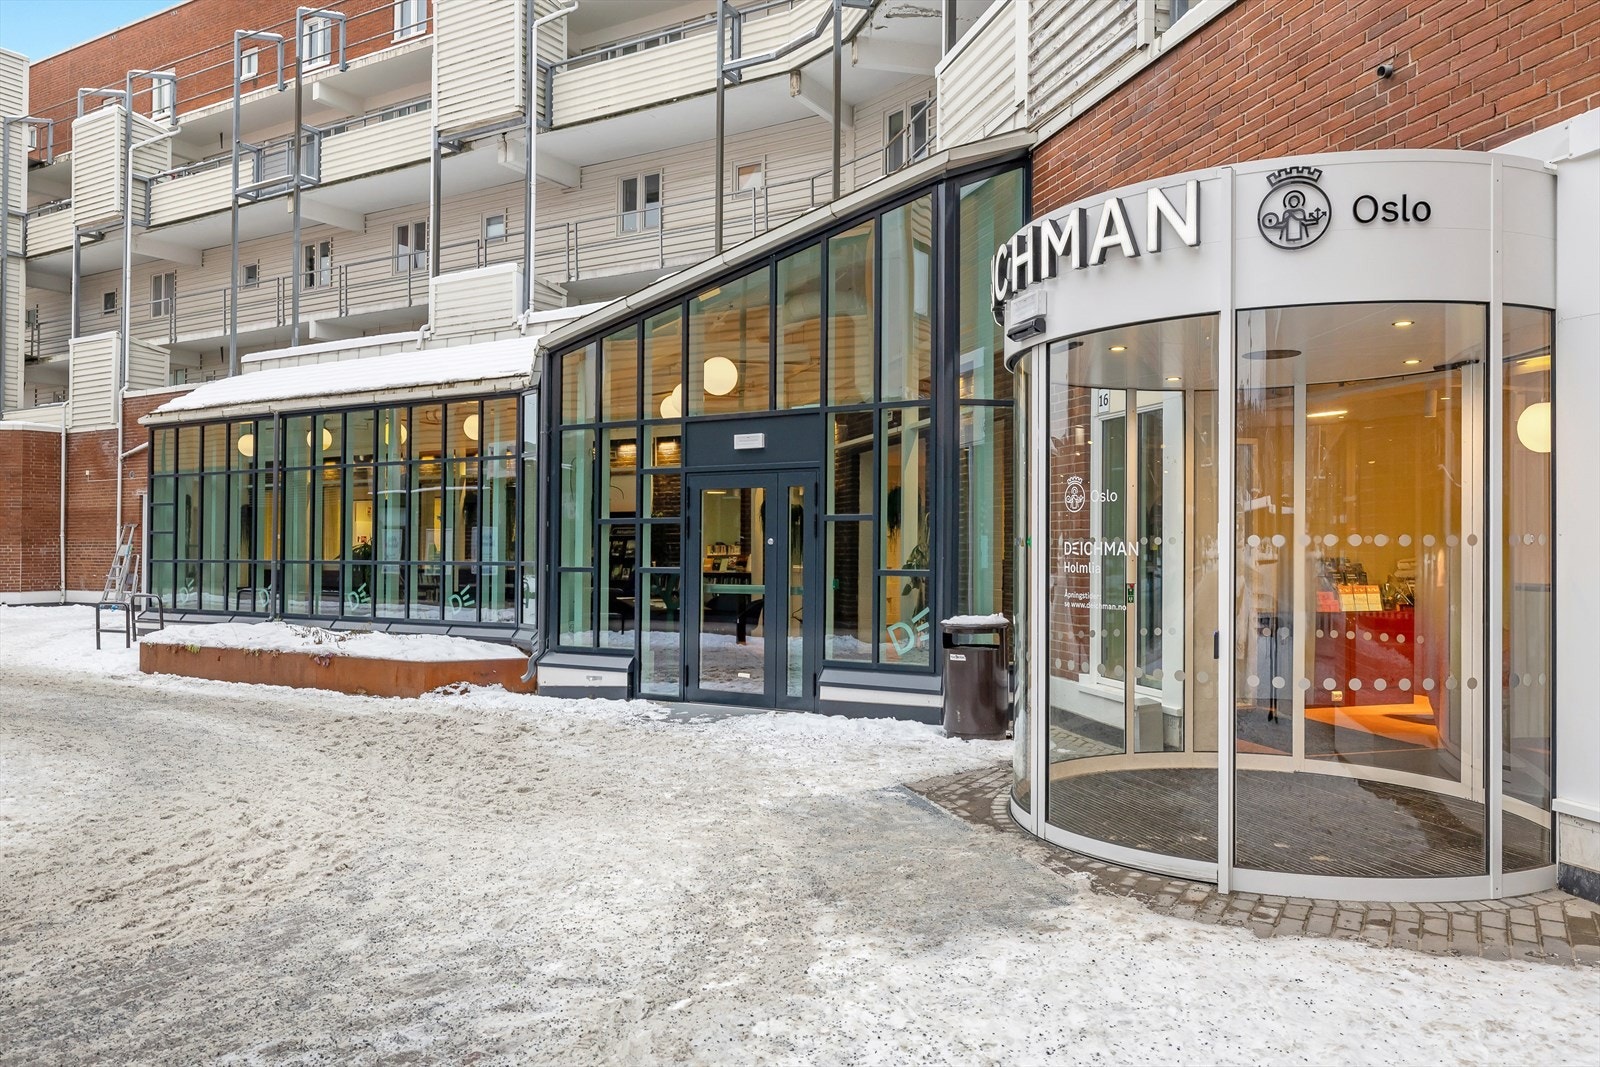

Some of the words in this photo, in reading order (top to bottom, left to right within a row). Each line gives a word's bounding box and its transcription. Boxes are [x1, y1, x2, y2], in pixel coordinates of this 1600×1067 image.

[1352, 193, 1432, 224] Oslo
[1099, 393, 1109, 407] 16
[1090, 489, 1118, 503] Oslo
[1063, 541, 1139, 557] DEICHMAN
[1063, 561, 1101, 574] Holmlia
[347, 582, 372, 612] DE
[447, 584, 476, 616] DE
